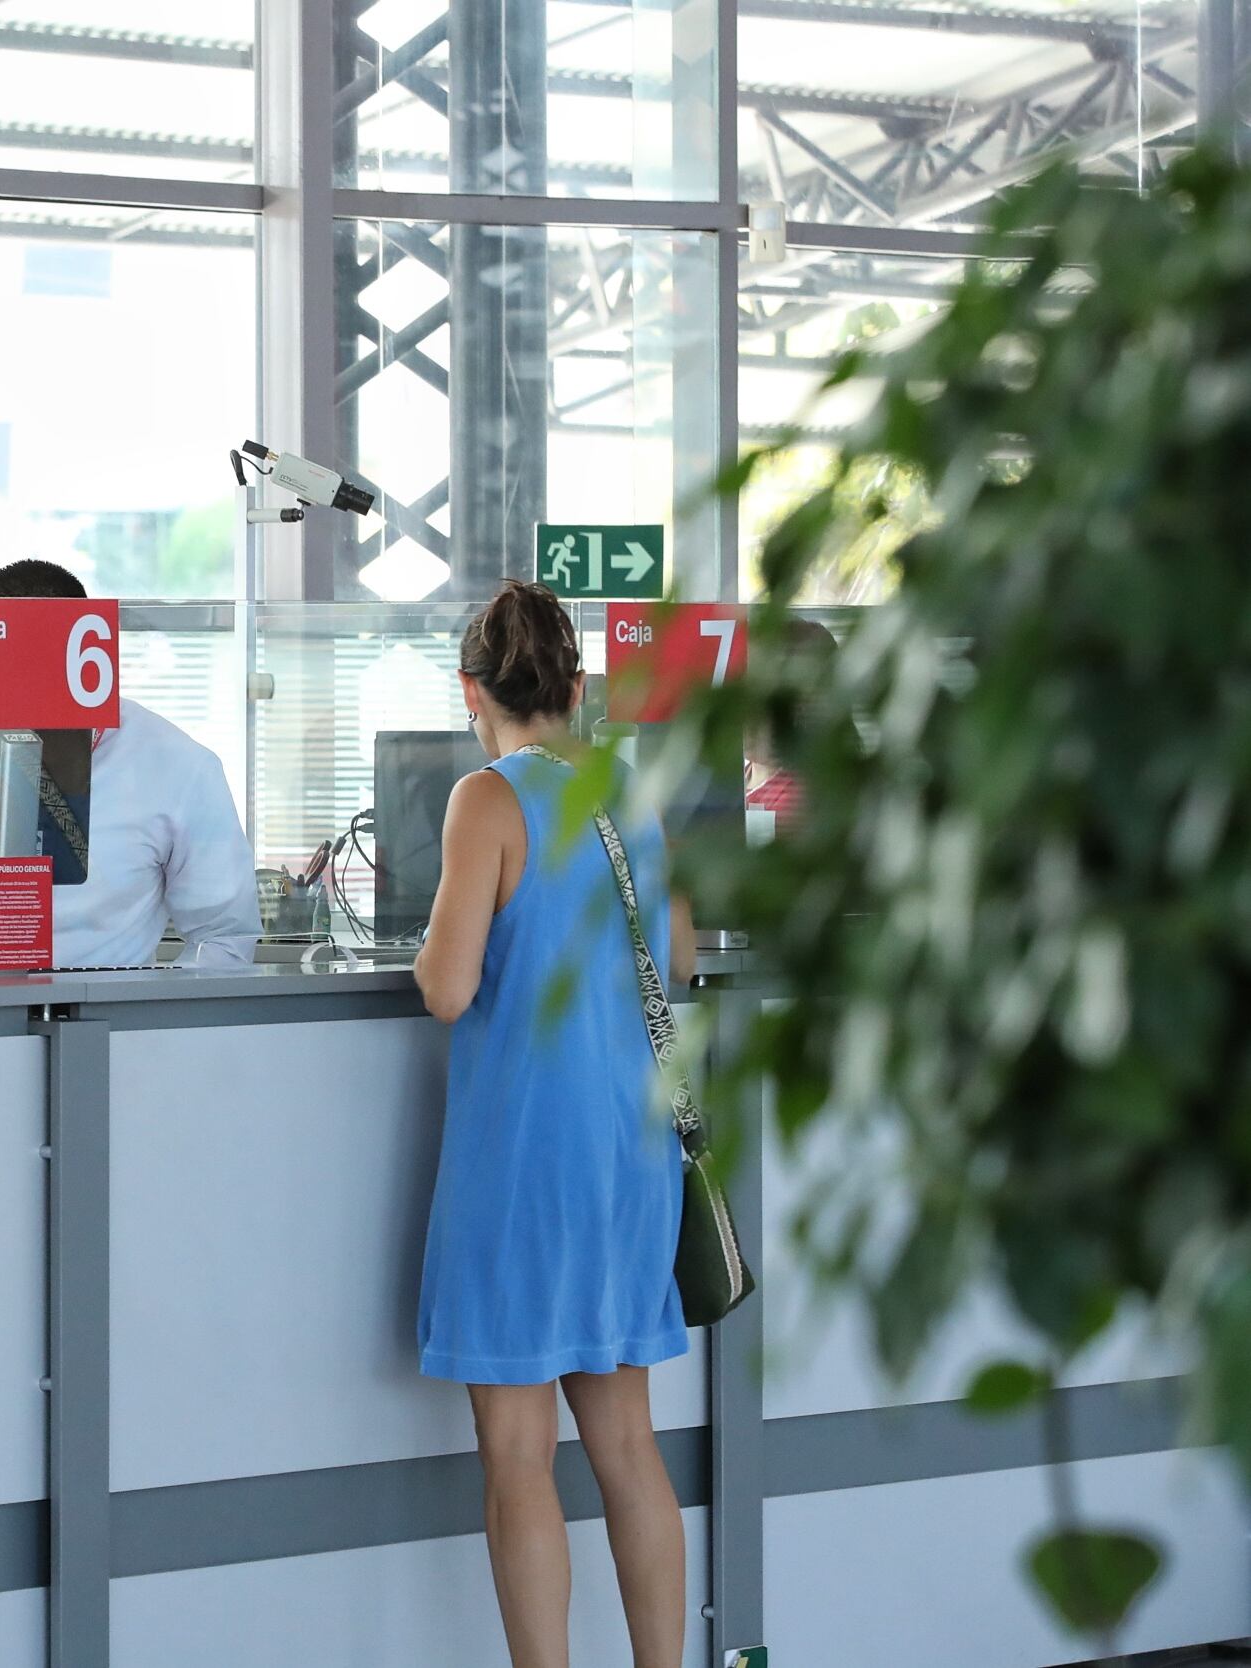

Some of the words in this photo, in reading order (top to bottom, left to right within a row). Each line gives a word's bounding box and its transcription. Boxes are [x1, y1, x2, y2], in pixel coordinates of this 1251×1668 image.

[65, 613, 114, 708] 6
[615, 619, 653, 648] Caja
[699, 619, 737, 689] 7
[24, 864, 51, 873] GENERAL
